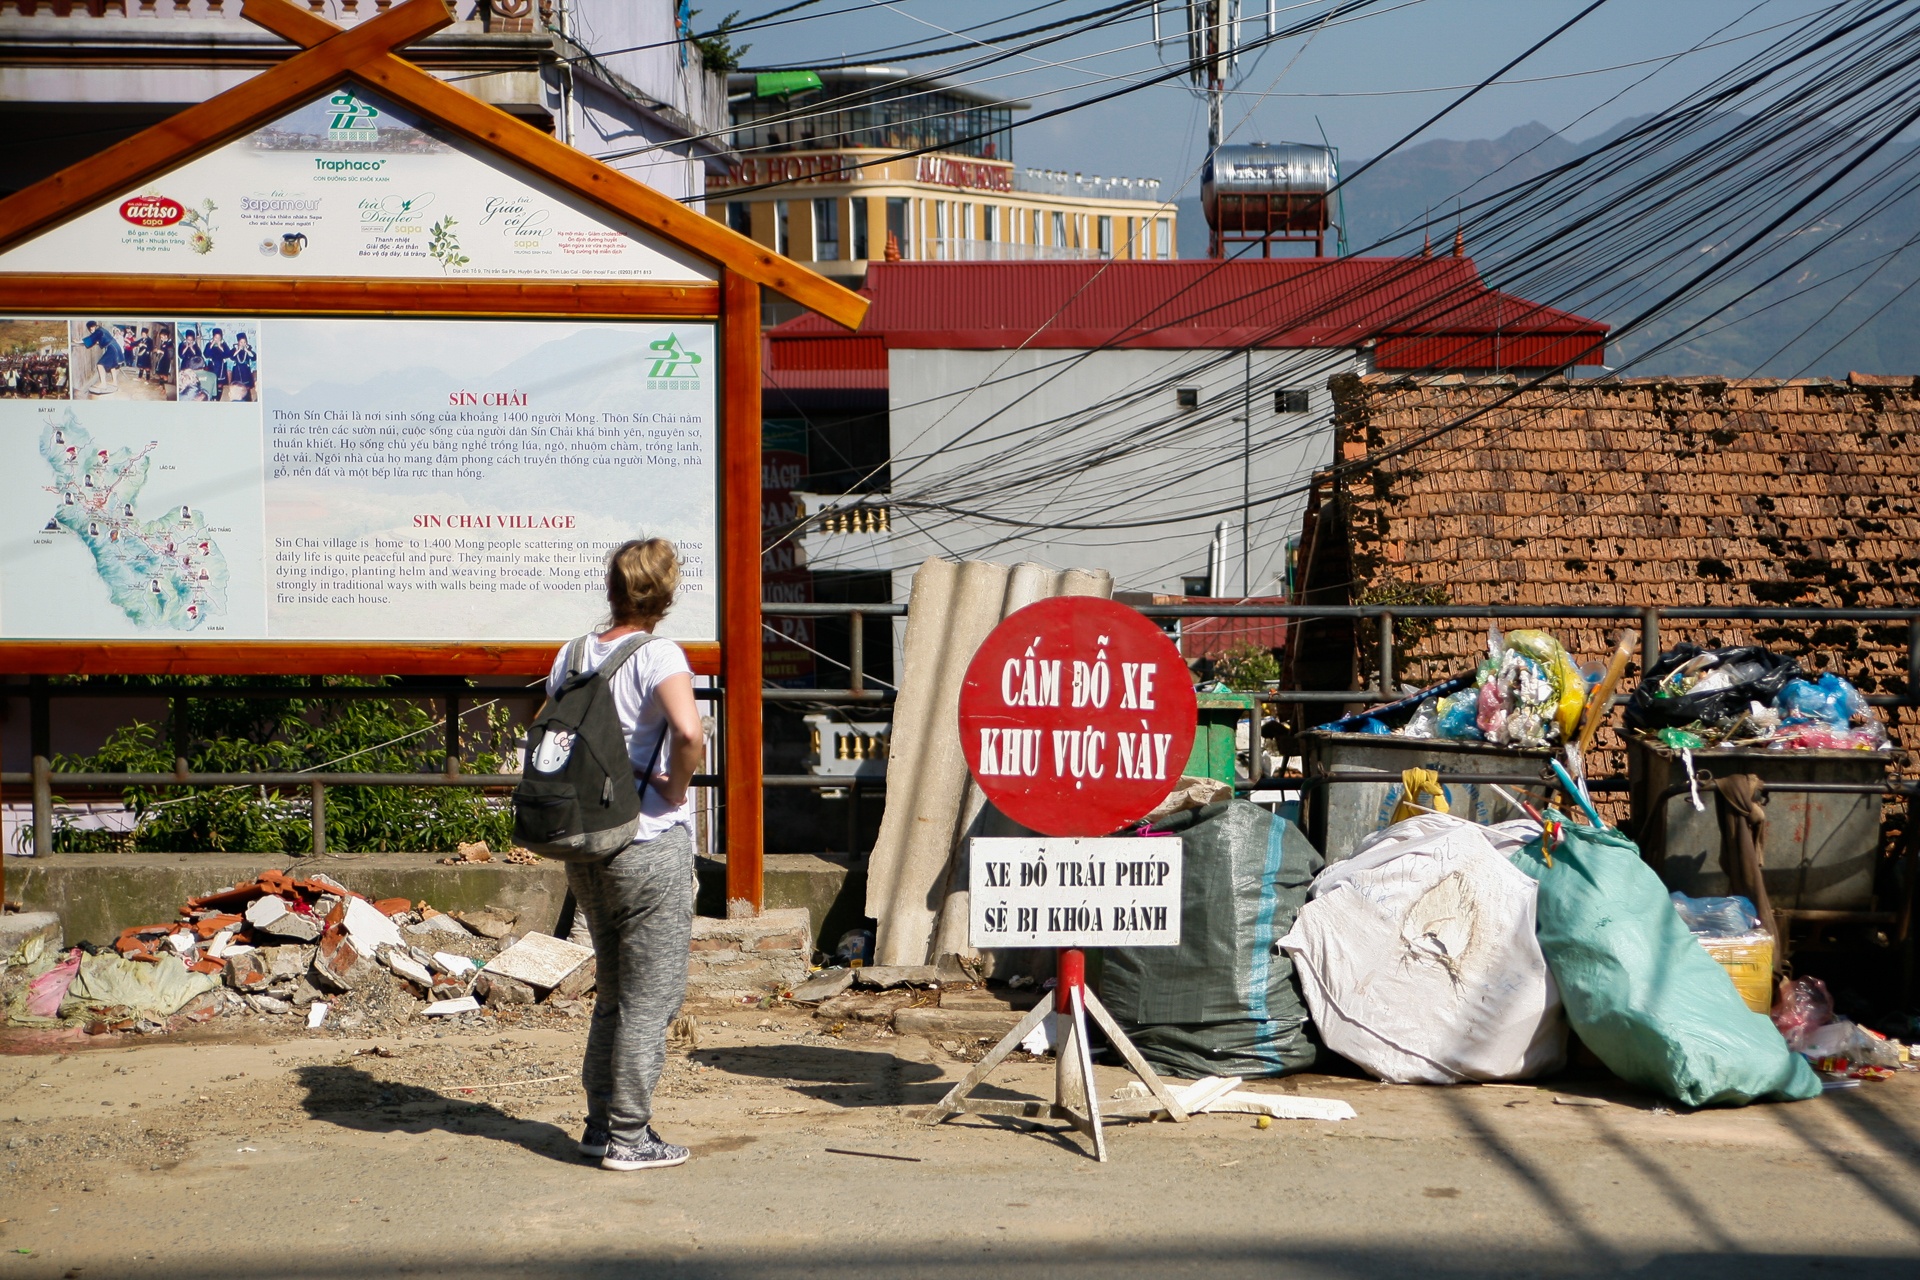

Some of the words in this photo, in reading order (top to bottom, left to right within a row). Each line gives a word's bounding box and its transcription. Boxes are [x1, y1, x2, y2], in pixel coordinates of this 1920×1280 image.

[768, 155, 850, 184] HOTEL
[127, 203, 177, 218] actiso
[395, 225, 422, 234] sapa
[450, 389, 477, 405] SÍN
[483, 389, 527, 406] CHẢI
[272, 410, 300, 420] Thôn
[304, 410, 320, 420] Sín
[324, 410, 348, 420] Chải
[352, 411, 361, 420] là
[365, 411, 381, 420] nơi
[385, 411, 406, 420] sinh
[411, 411, 435, 424] sống
[438, 411, 456, 421] của
[460, 411, 498, 424] khoảng
[504, 412, 528, 422] 1400
[532, 412, 560, 424] người
[565, 413, 598, 425] Mông.
[602, 413, 628, 422] Thôn
[633, 413, 648, 422] Sín
[652, 413, 676, 423] Chải
[680, 413, 701, 423] nằm
[273, 424, 286, 434] rải
[290, 424, 305, 434] rác
[309, 425, 328, 434] trên
[332, 425, 348, 434] các
[352, 425, 376, 434] sườn
[380, 425, 398, 436] núi,
[402, 426, 426, 437] cuộc
[430, 425, 453, 438] sống
[456, 426, 474, 435] của
[478, 426, 505, 438] người
[509, 426, 527, 436] dân
[531, 426, 546, 436] Sín
[550, 426, 572, 436] Chải
[577, 427, 594, 436] khá
[598, 427, 620, 436] bình
[624, 428, 644, 439] yên,
[648, 428, 684, 439] nguyên
[688, 430, 702, 438] sơ,
[274, 465, 290, 478] gỗ,
[293, 466, 311, 476] nền
[315, 466, 330, 476] đất
[334, 467, 345, 476] và
[349, 468, 368, 479] một
[372, 467, 390, 479] bếp
[394, 467, 408, 477] lửa
[412, 470, 428, 479] rực
[432, 468, 453, 477] than
[457, 467, 484, 480] hồng.
[762, 458, 800, 488] HÁCH
[413, 514, 441, 528] SIN
[447, 515, 491, 528] CHAI
[498, 515, 576, 528] VILLAGE
[276, 538, 292, 547] Sin
[296, 538, 318, 547] Chai
[323, 538, 357, 550] village
[361, 538, 368, 547] is
[376, 538, 403, 548] home
[410, 540, 419, 548] to
[424, 539, 451, 548] 1.400
[455, 539, 484, 551] Mong
[488, 539, 521, 551] people
[525, 539, 573, 551] scattering
[276, 552, 300, 564] daily
[304, 552, 320, 561] life
[324, 552, 332, 561] is
[335, 552, 360, 564] quite
[364, 552, 405, 564] peaceful
[409, 552, 426, 562] and
[430, 555, 454, 564] pure.
[458, 553, 482, 564] They
[486, 553, 520, 565] mainly
[524, 553, 550, 562] make
[554, 553, 576, 562] their
[686, 554, 703, 564] ice,
[276, 565, 306, 578] dying
[311, 566, 348, 578] indigo,
[352, 566, 396, 578] planting
[400, 566, 425, 576] helm
[429, 566, 448, 576] and
[452, 567, 496, 578] weaving
[500, 567, 545, 576] brocade.
[550, 567, 580, 579] Mong
[680, 568, 702, 577] built
[277, 580, 317, 592] strongly
[321, 580, 329, 589] in
[333, 580, 383, 589] traditional
[387, 583, 412, 592] ways
[416, 580, 437, 589] with
[440, 580, 466, 590] walls
[470, 580, 496, 592] being
[500, 581, 526, 590] made
[530, 581, 541, 590] of
[543, 581, 581, 590] wooden
[680, 584, 703, 593] open
[278, 593, 294, 603] fire
[298, 593, 328, 603] inside
[332, 594, 354, 603] each
[358, 594, 390, 603] house.
[1001, 637, 1060, 708] CẤM
[1072, 635, 1109, 708] ĐỖ
[1120, 662, 1156, 710] XE
[978, 728, 1042, 777] KHU
[1052, 725, 1107, 790] VỰC
[1115, 720, 1172, 780] NÀY
[984, 862, 1010, 887] XE
[1020, 848, 1047, 887] ĐỖ
[1056, 854, 1106, 887] TRÁI
[1115, 854, 1170, 887] PHÉP
[984, 901, 1008, 933] SẼ
[1018, 907, 1038, 940] BỊ
[1048, 900, 1103, 932] KHÓA
[1113, 899, 1168, 931] BÁNH
